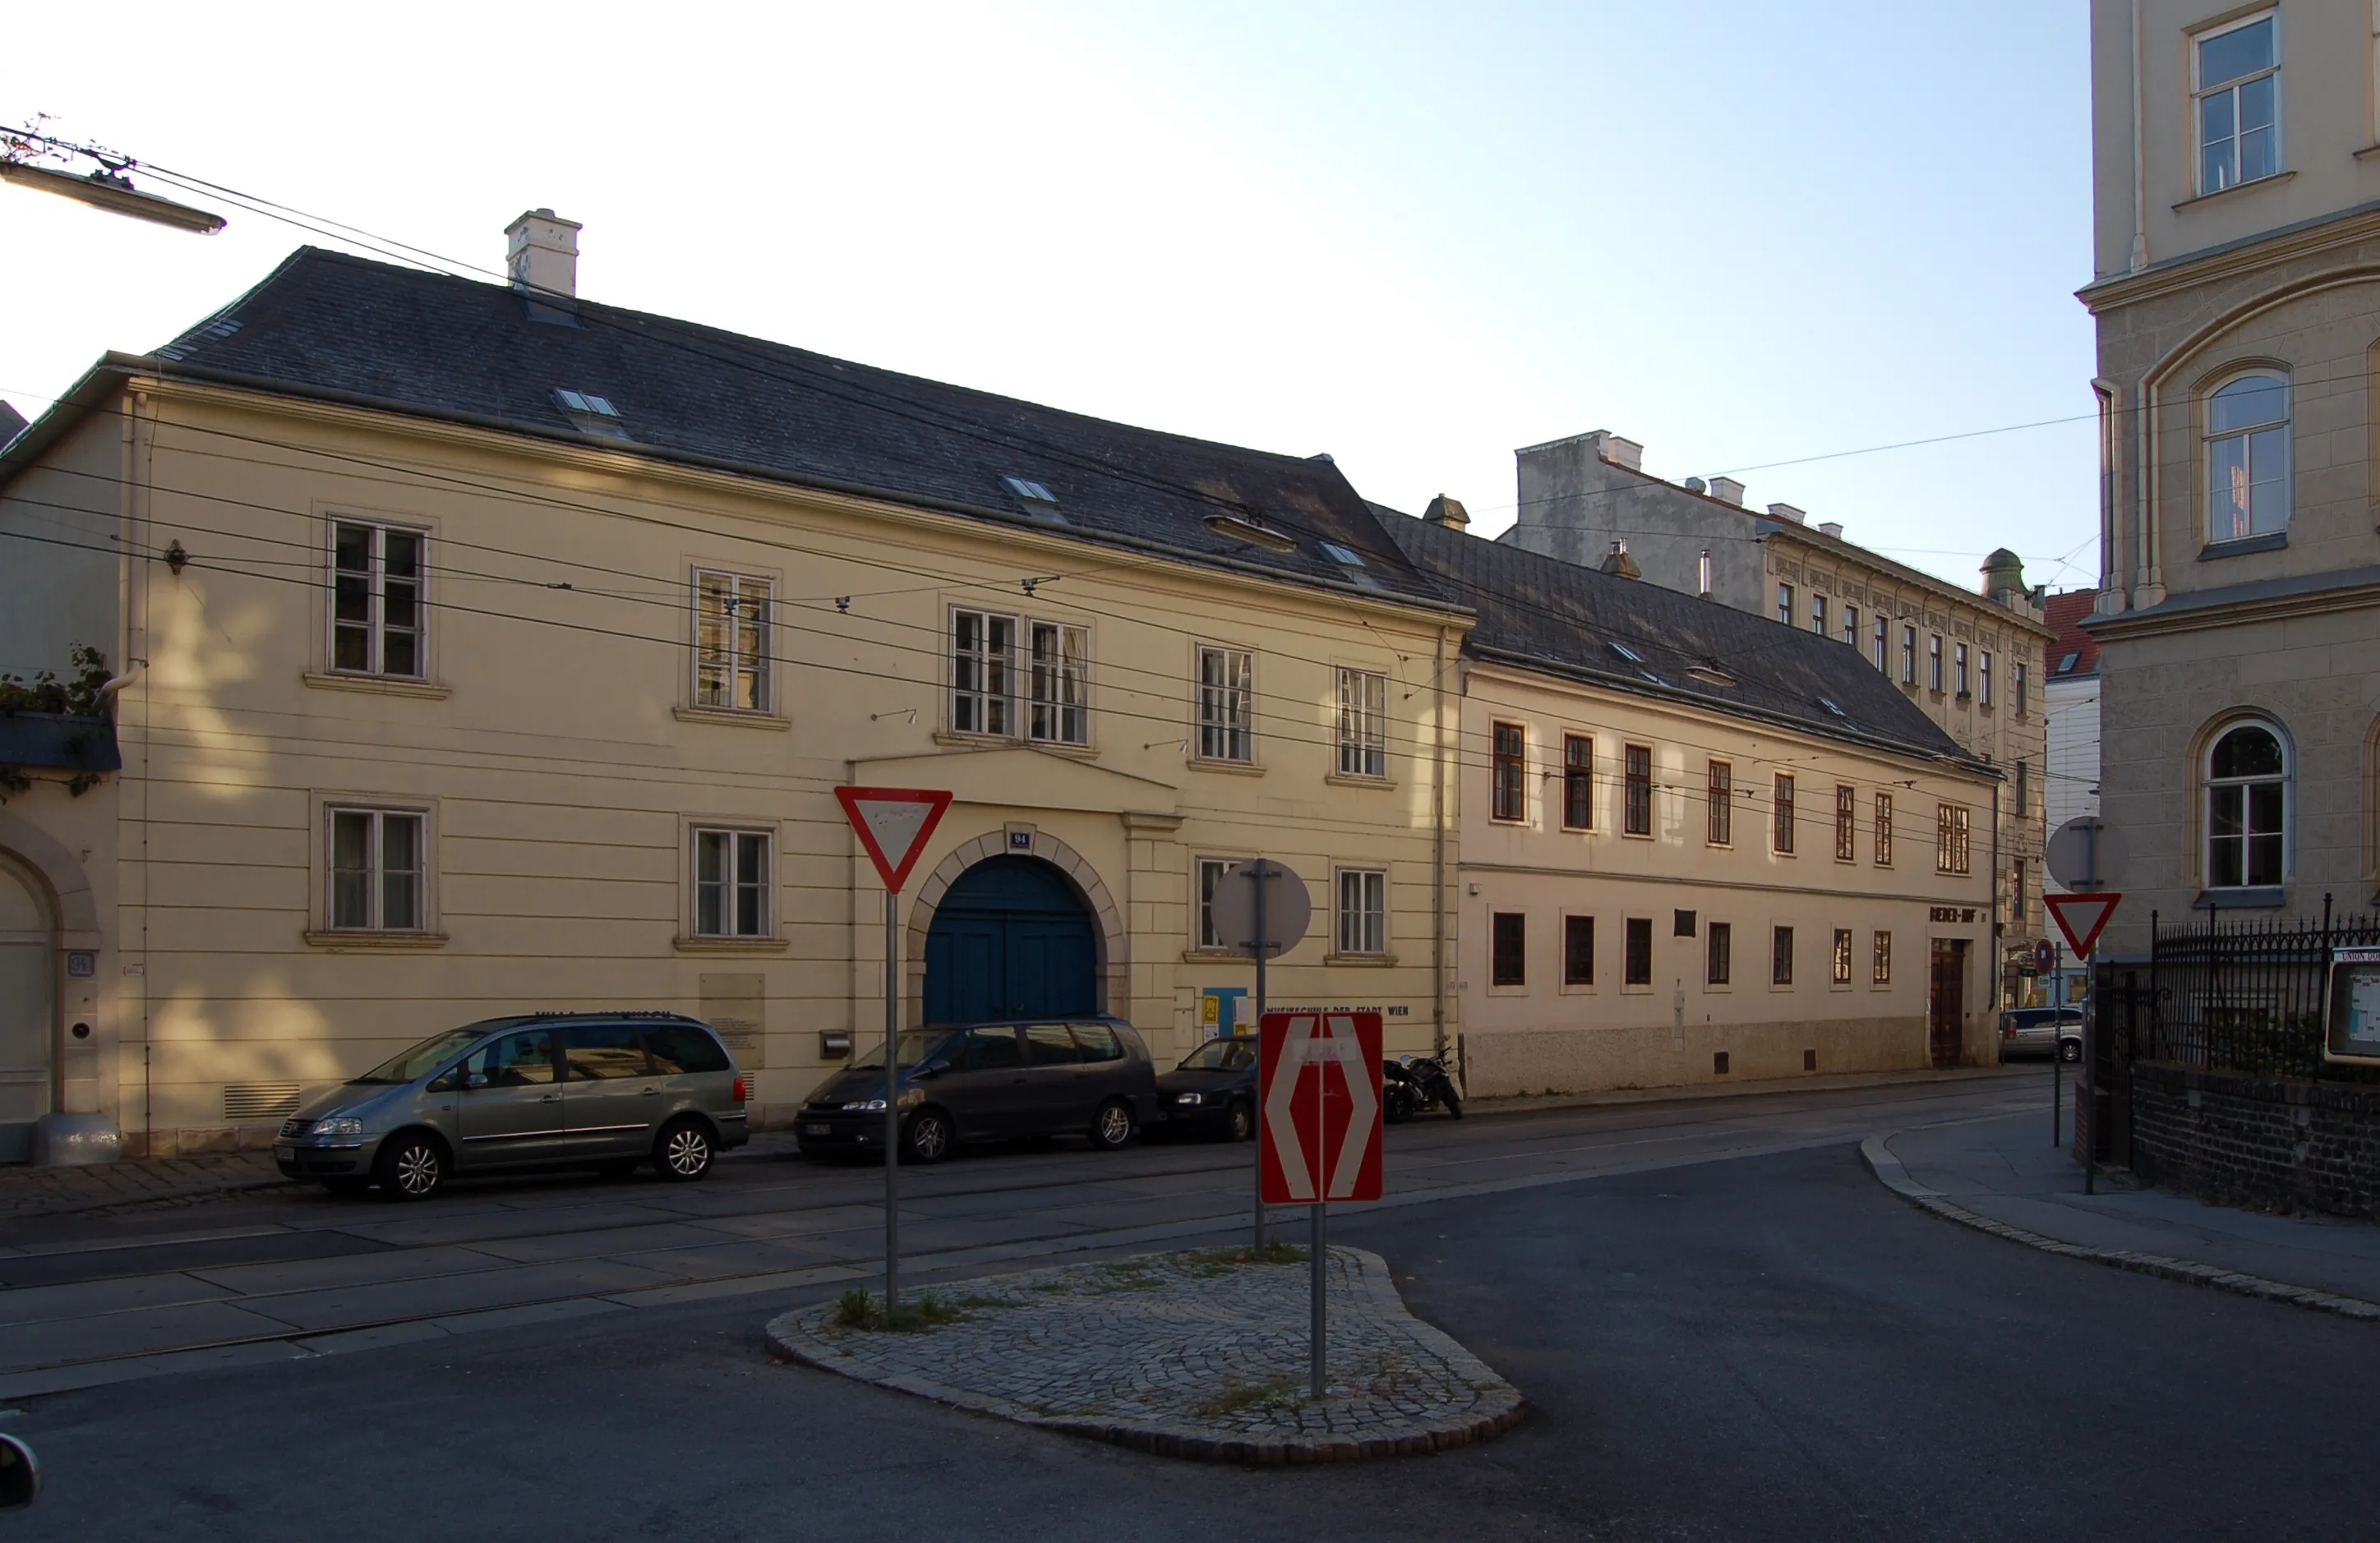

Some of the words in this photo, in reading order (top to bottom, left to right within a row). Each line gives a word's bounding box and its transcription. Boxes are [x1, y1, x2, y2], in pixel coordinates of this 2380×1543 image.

[1014, 834, 1026, 844] 94
[2342, 952, 2364, 960] UNION
[71, 957, 88, 971] 94
[1387, 1006, 1408, 1016] WIEN
